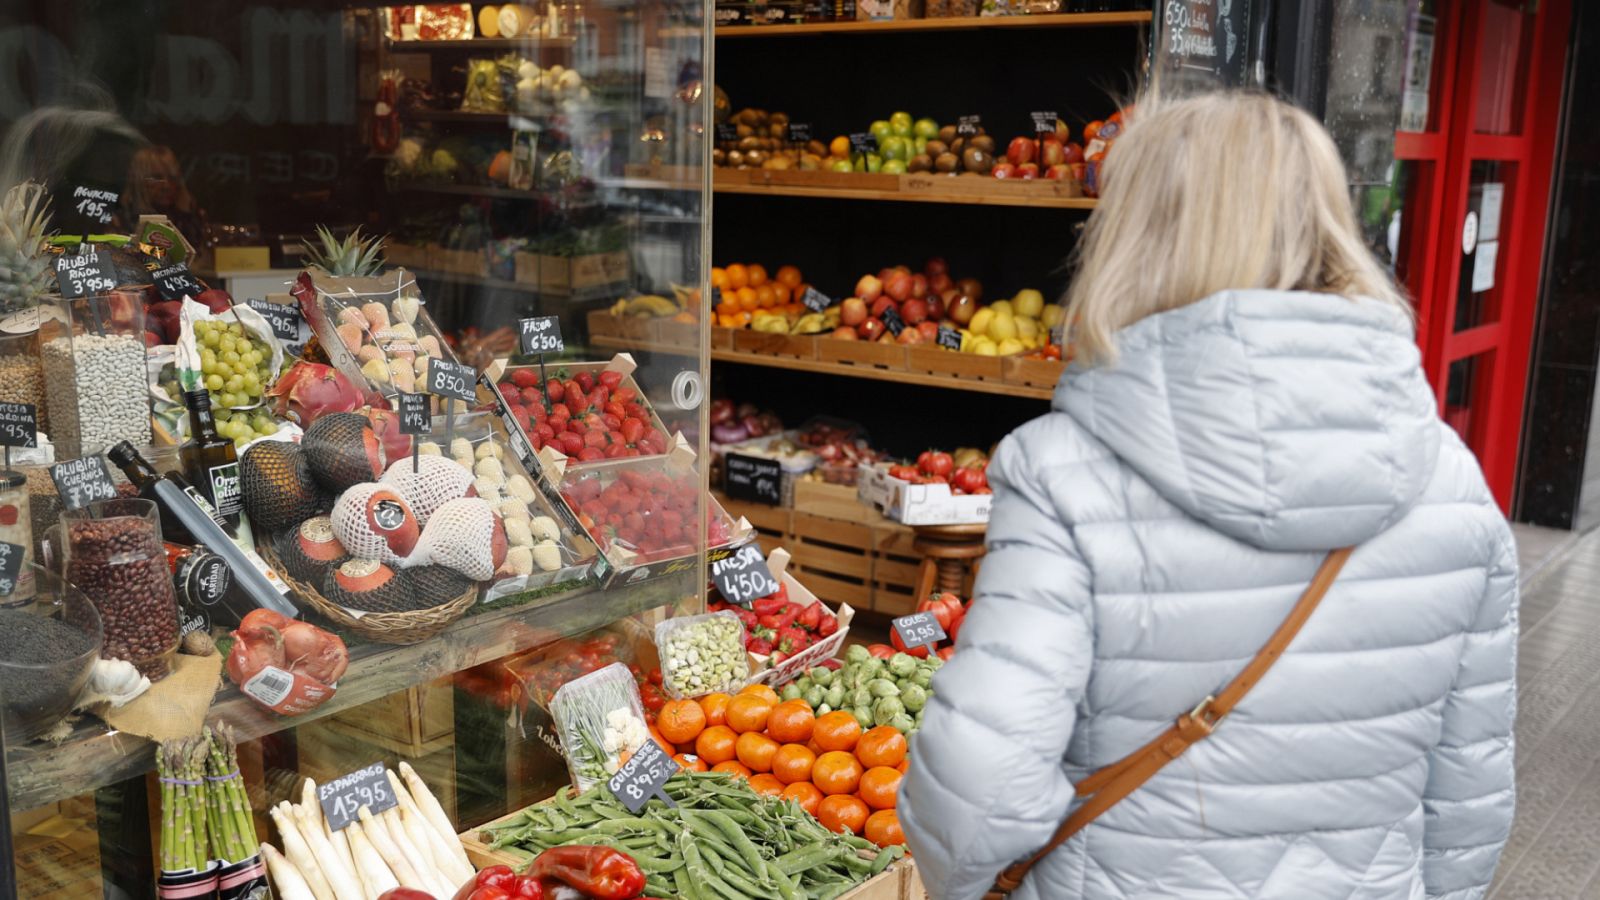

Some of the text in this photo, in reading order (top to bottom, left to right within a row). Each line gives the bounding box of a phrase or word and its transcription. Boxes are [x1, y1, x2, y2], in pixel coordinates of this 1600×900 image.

[207, 563, 220, 598] CARIDAD
[724, 571, 767, 602] 4'50
[905, 623, 936, 643] 2,95
[333, 780, 386, 821] 15'95
